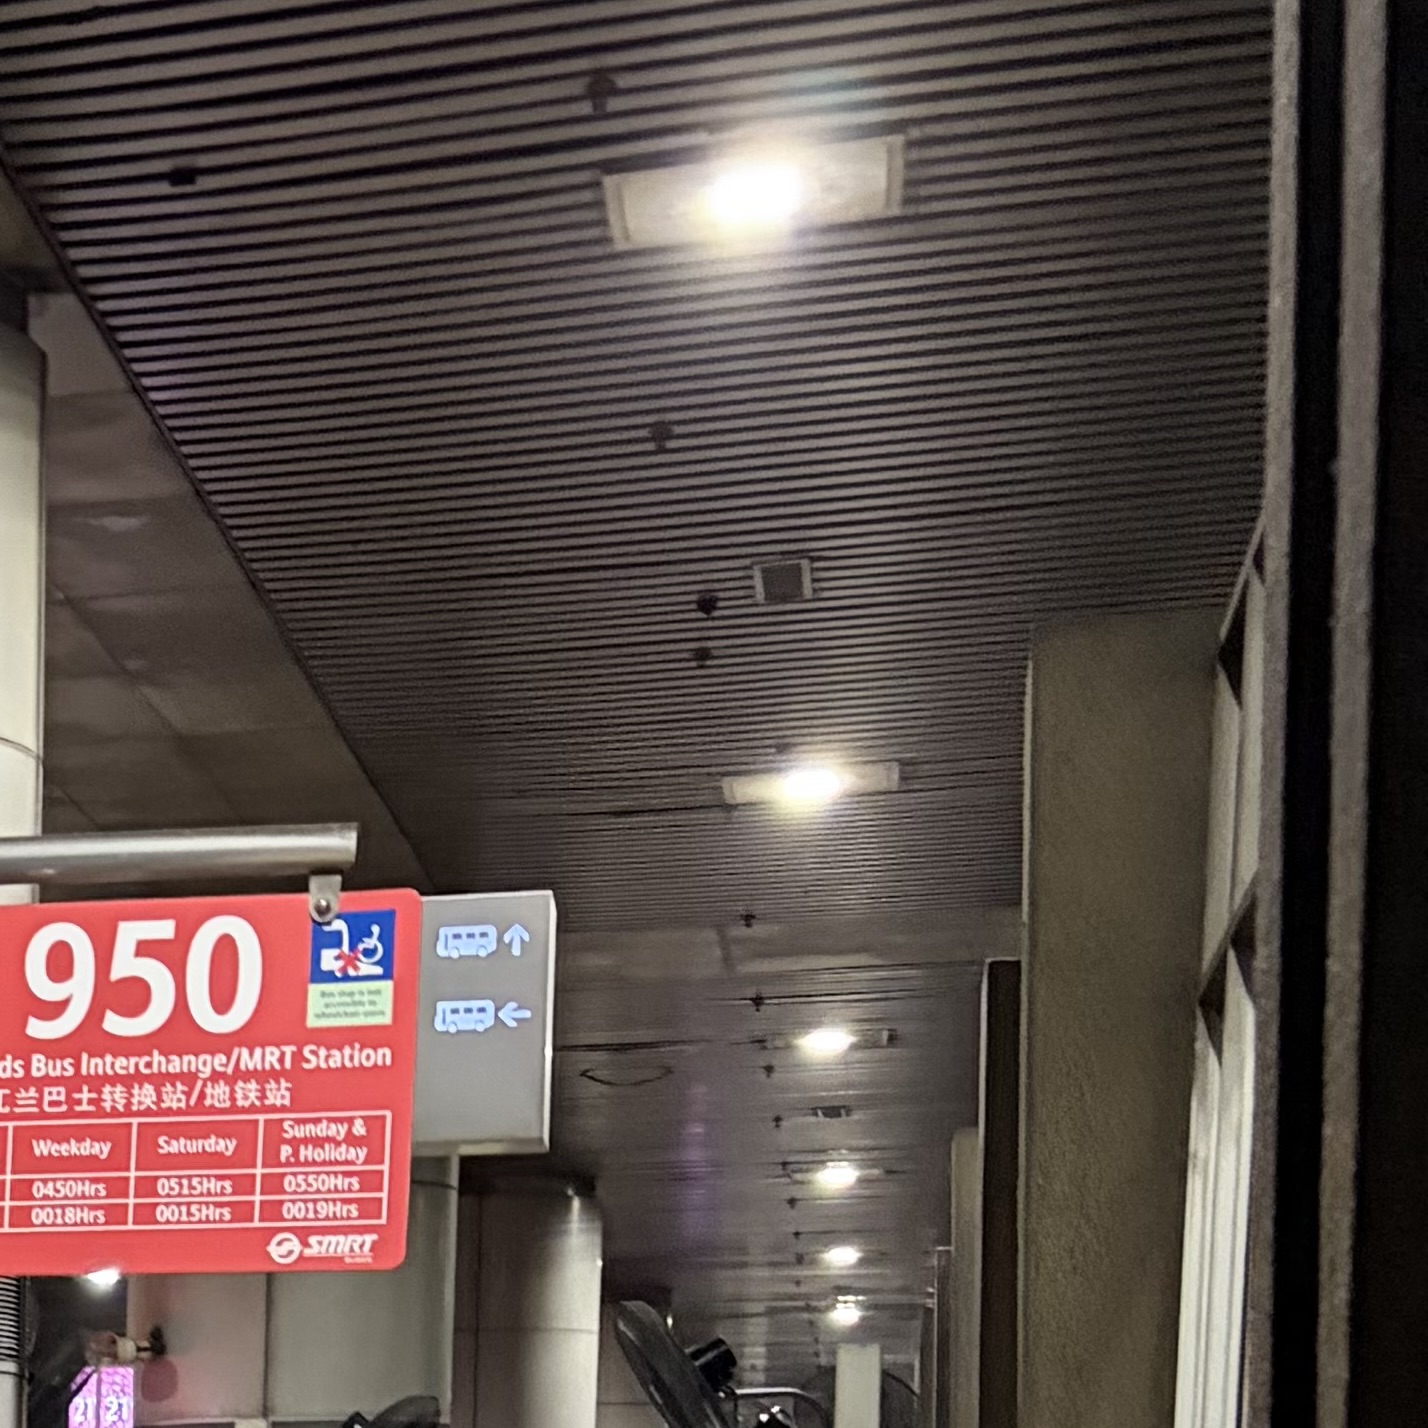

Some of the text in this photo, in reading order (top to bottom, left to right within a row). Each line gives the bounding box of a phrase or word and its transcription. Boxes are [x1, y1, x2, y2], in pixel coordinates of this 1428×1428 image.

[24, 914, 263, 1040] 950
[30, 1053, 75, 1079] Bus
[80, 1045, 298, 1079] Interchange/MRT
[301, 1042, 393, 1070] Station
[281, 1117, 367, 1141] Sunday &
[31, 1137, 113, 1160] Weekday
[157, 1134, 237, 1157] Saturday
[279, 1143, 368, 1165] P. Holiday
[31, 1179, 107, 1199] 0450Hrs
[156, 1177, 233, 1197] 0515Hrs
[283, 1173, 360, 1193] 0550Hrs
[30, 1207, 106, 1226] 0018Hrs
[155, 1204, 232, 1223] 0015Hrs
[281, 1201, 359, 1220] 0019Hrs
[303, 1232, 379, 1256] SMRT
[74, 1397, 92, 1426] 21
[104, 1395, 129, 1422] 21
